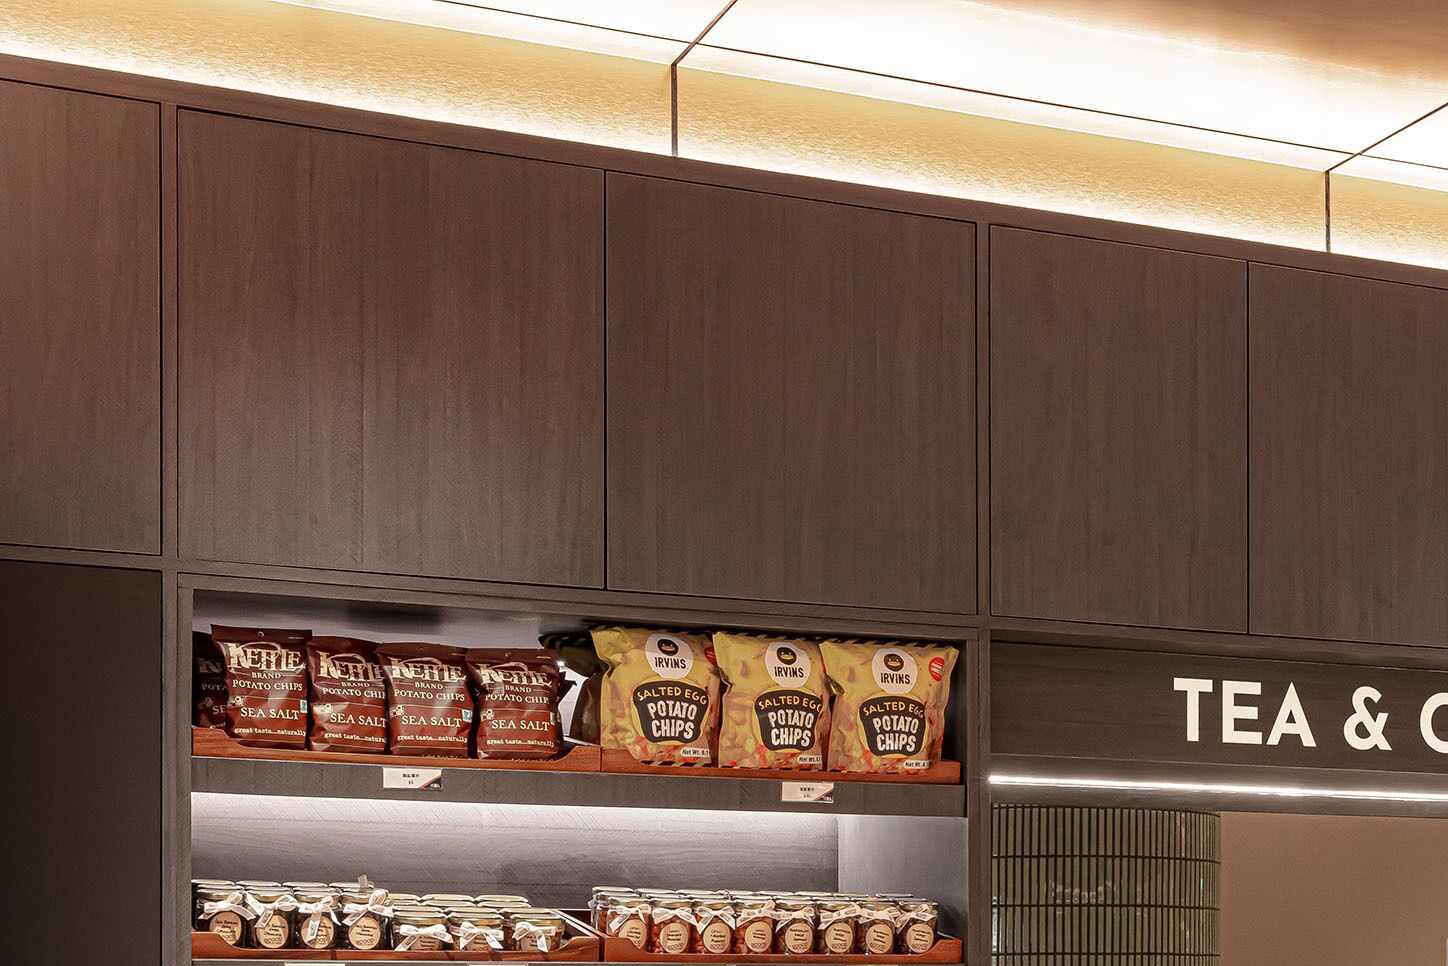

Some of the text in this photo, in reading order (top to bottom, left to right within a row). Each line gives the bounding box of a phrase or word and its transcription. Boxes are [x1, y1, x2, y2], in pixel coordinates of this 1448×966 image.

[654, 656, 687, 669] IRVINS
[774, 666, 805, 678] IRVINS
[881, 673, 911, 684] IRVINS
[201, 683, 227, 691] POTA
[232, 680, 303, 691] POTATO CHIPS
[322, 687, 362, 696] POTATO
[505, 685, 532, 693] BRAND
[394, 689, 465, 701] POTATO CHIPS
[485, 694, 550, 704] POTATO CHIP
[637, 687, 707, 705] SALTED EGG
[758, 695, 800, 710] SALTED
[212, 705, 226, 715] SE
[240, 706, 299, 720] SEA SALT
[647, 700, 698, 720] POTATO
[863, 701, 923, 718] SALTED EGG
[1173, 677, 1316, 748] TEA
[1343, 686, 1392, 751] &
[330, 713, 387, 728] SEA SALT
[401, 715, 462, 727] SEA SALT
[491, 719, 550, 731] SEA SALT
[768, 709, 814, 728] POTATO
[872, 715, 919, 734] POTATO
[651, 719, 695, 739] CHIPS
[771, 728, 812, 747] CHIPS
[876, 734, 916, 752] CHIPS
